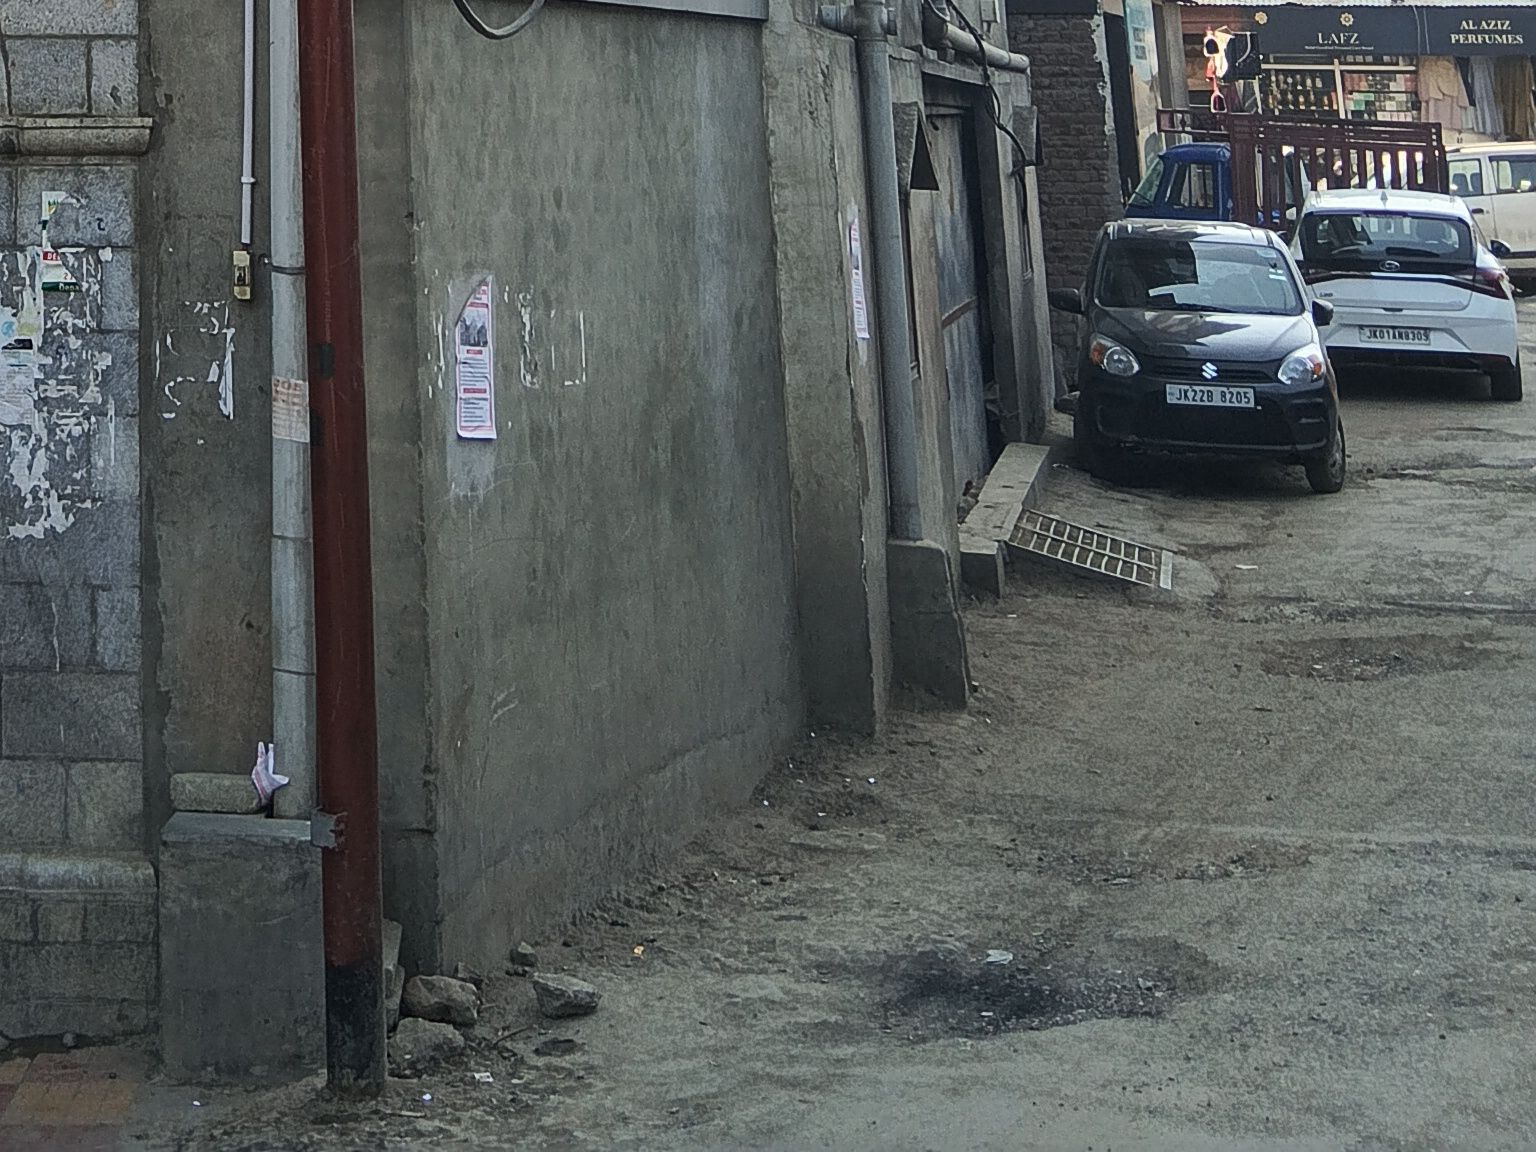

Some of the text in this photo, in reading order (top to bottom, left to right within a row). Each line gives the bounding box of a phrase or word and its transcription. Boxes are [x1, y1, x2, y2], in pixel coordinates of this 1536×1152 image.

[1460, 20, 1511, 30] AL AZIZ
[1318, 33, 1359, 44] LAFZ
[1450, 34, 1524, 44] PERFUMES
[1175, 388, 1214, 403] JK22B
[1220, 390, 1251, 404] 8205
